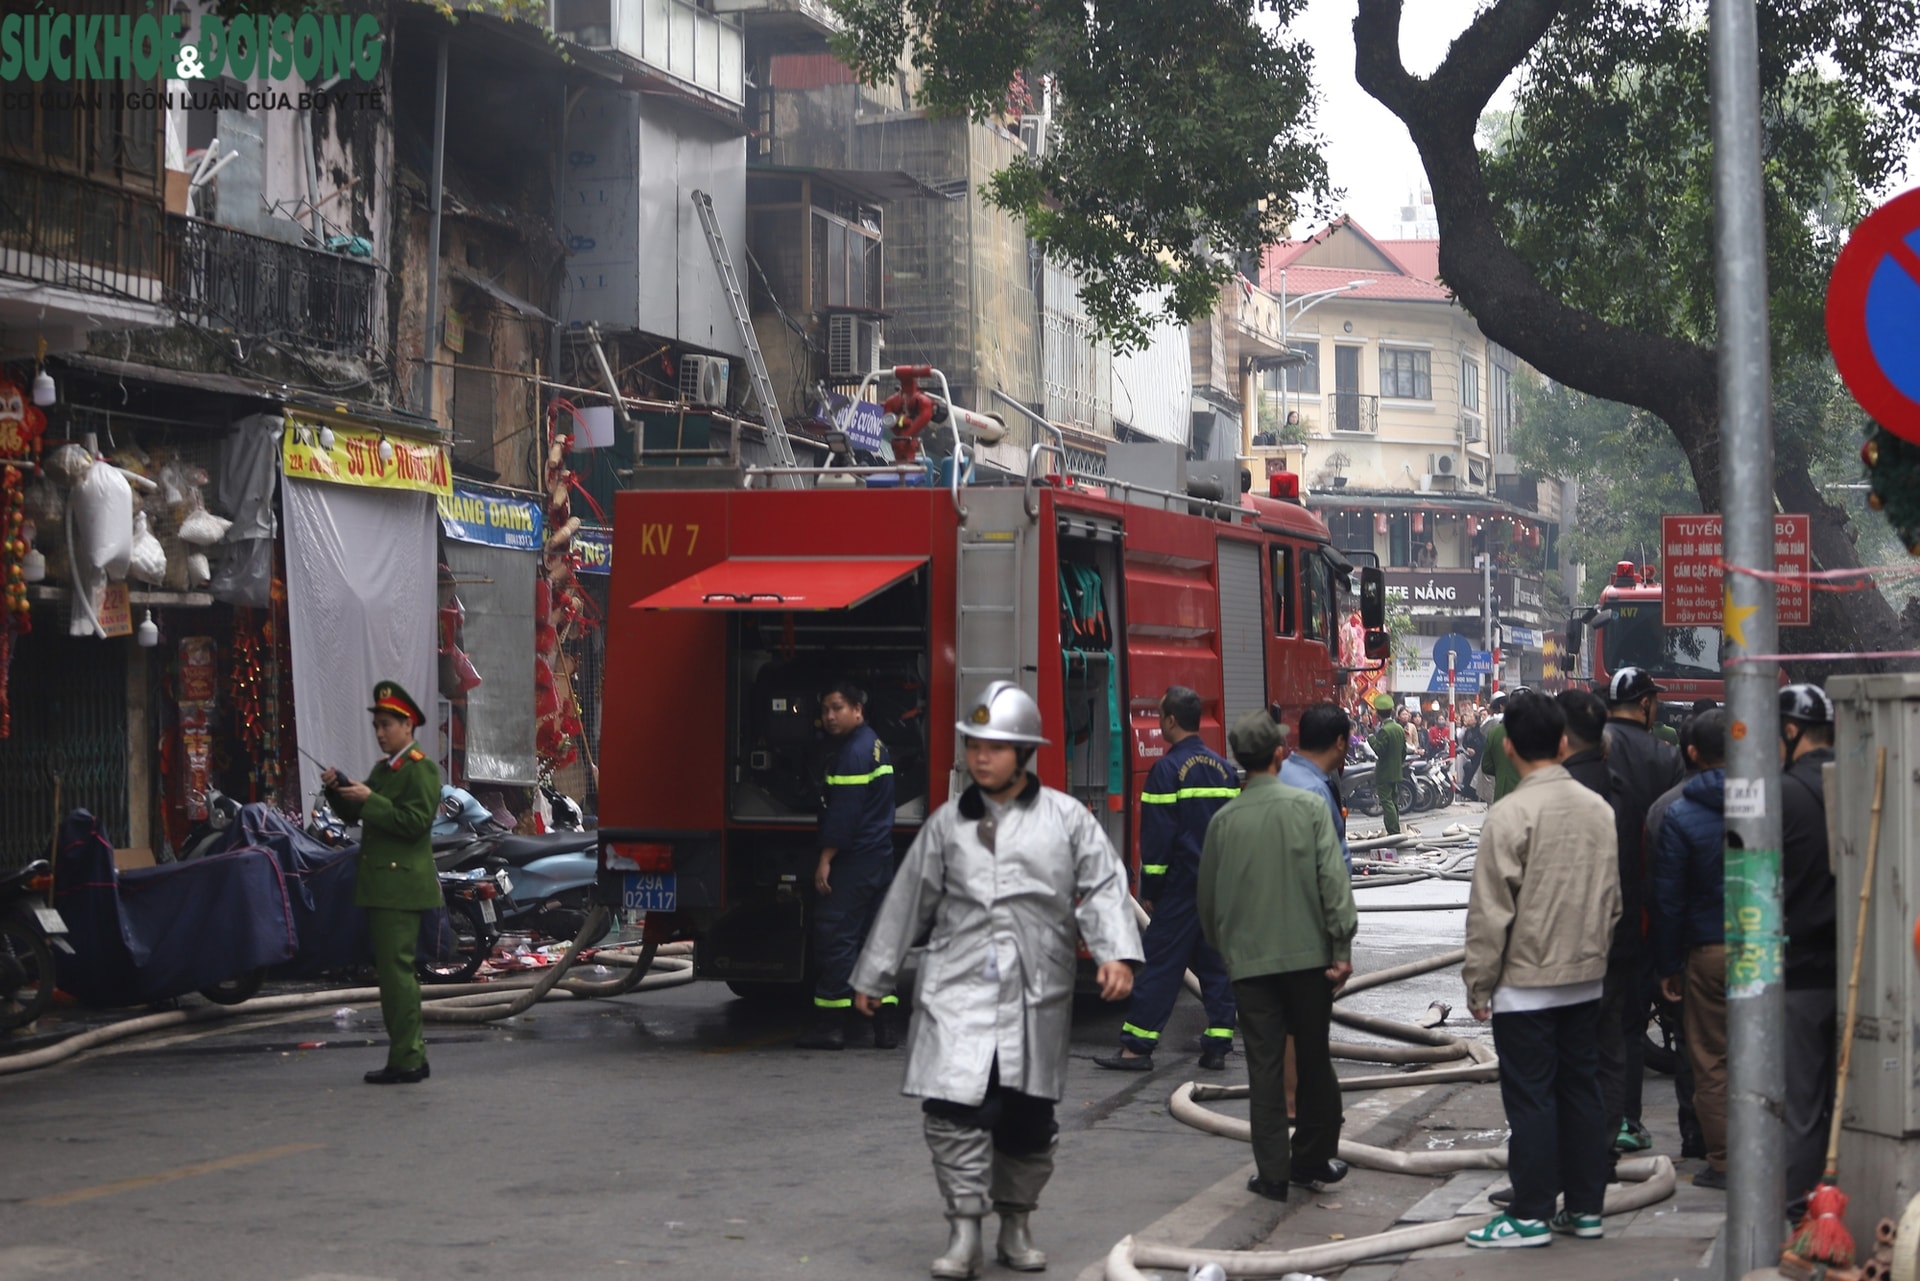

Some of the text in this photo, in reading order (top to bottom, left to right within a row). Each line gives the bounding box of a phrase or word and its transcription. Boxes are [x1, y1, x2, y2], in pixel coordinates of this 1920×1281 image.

[1678, 519, 1795, 538] TUYẾN BỘ
[641, 524, 700, 556] KV 7
[636, 874, 663, 891] 29A
[625, 891, 674, 909] 021.17
